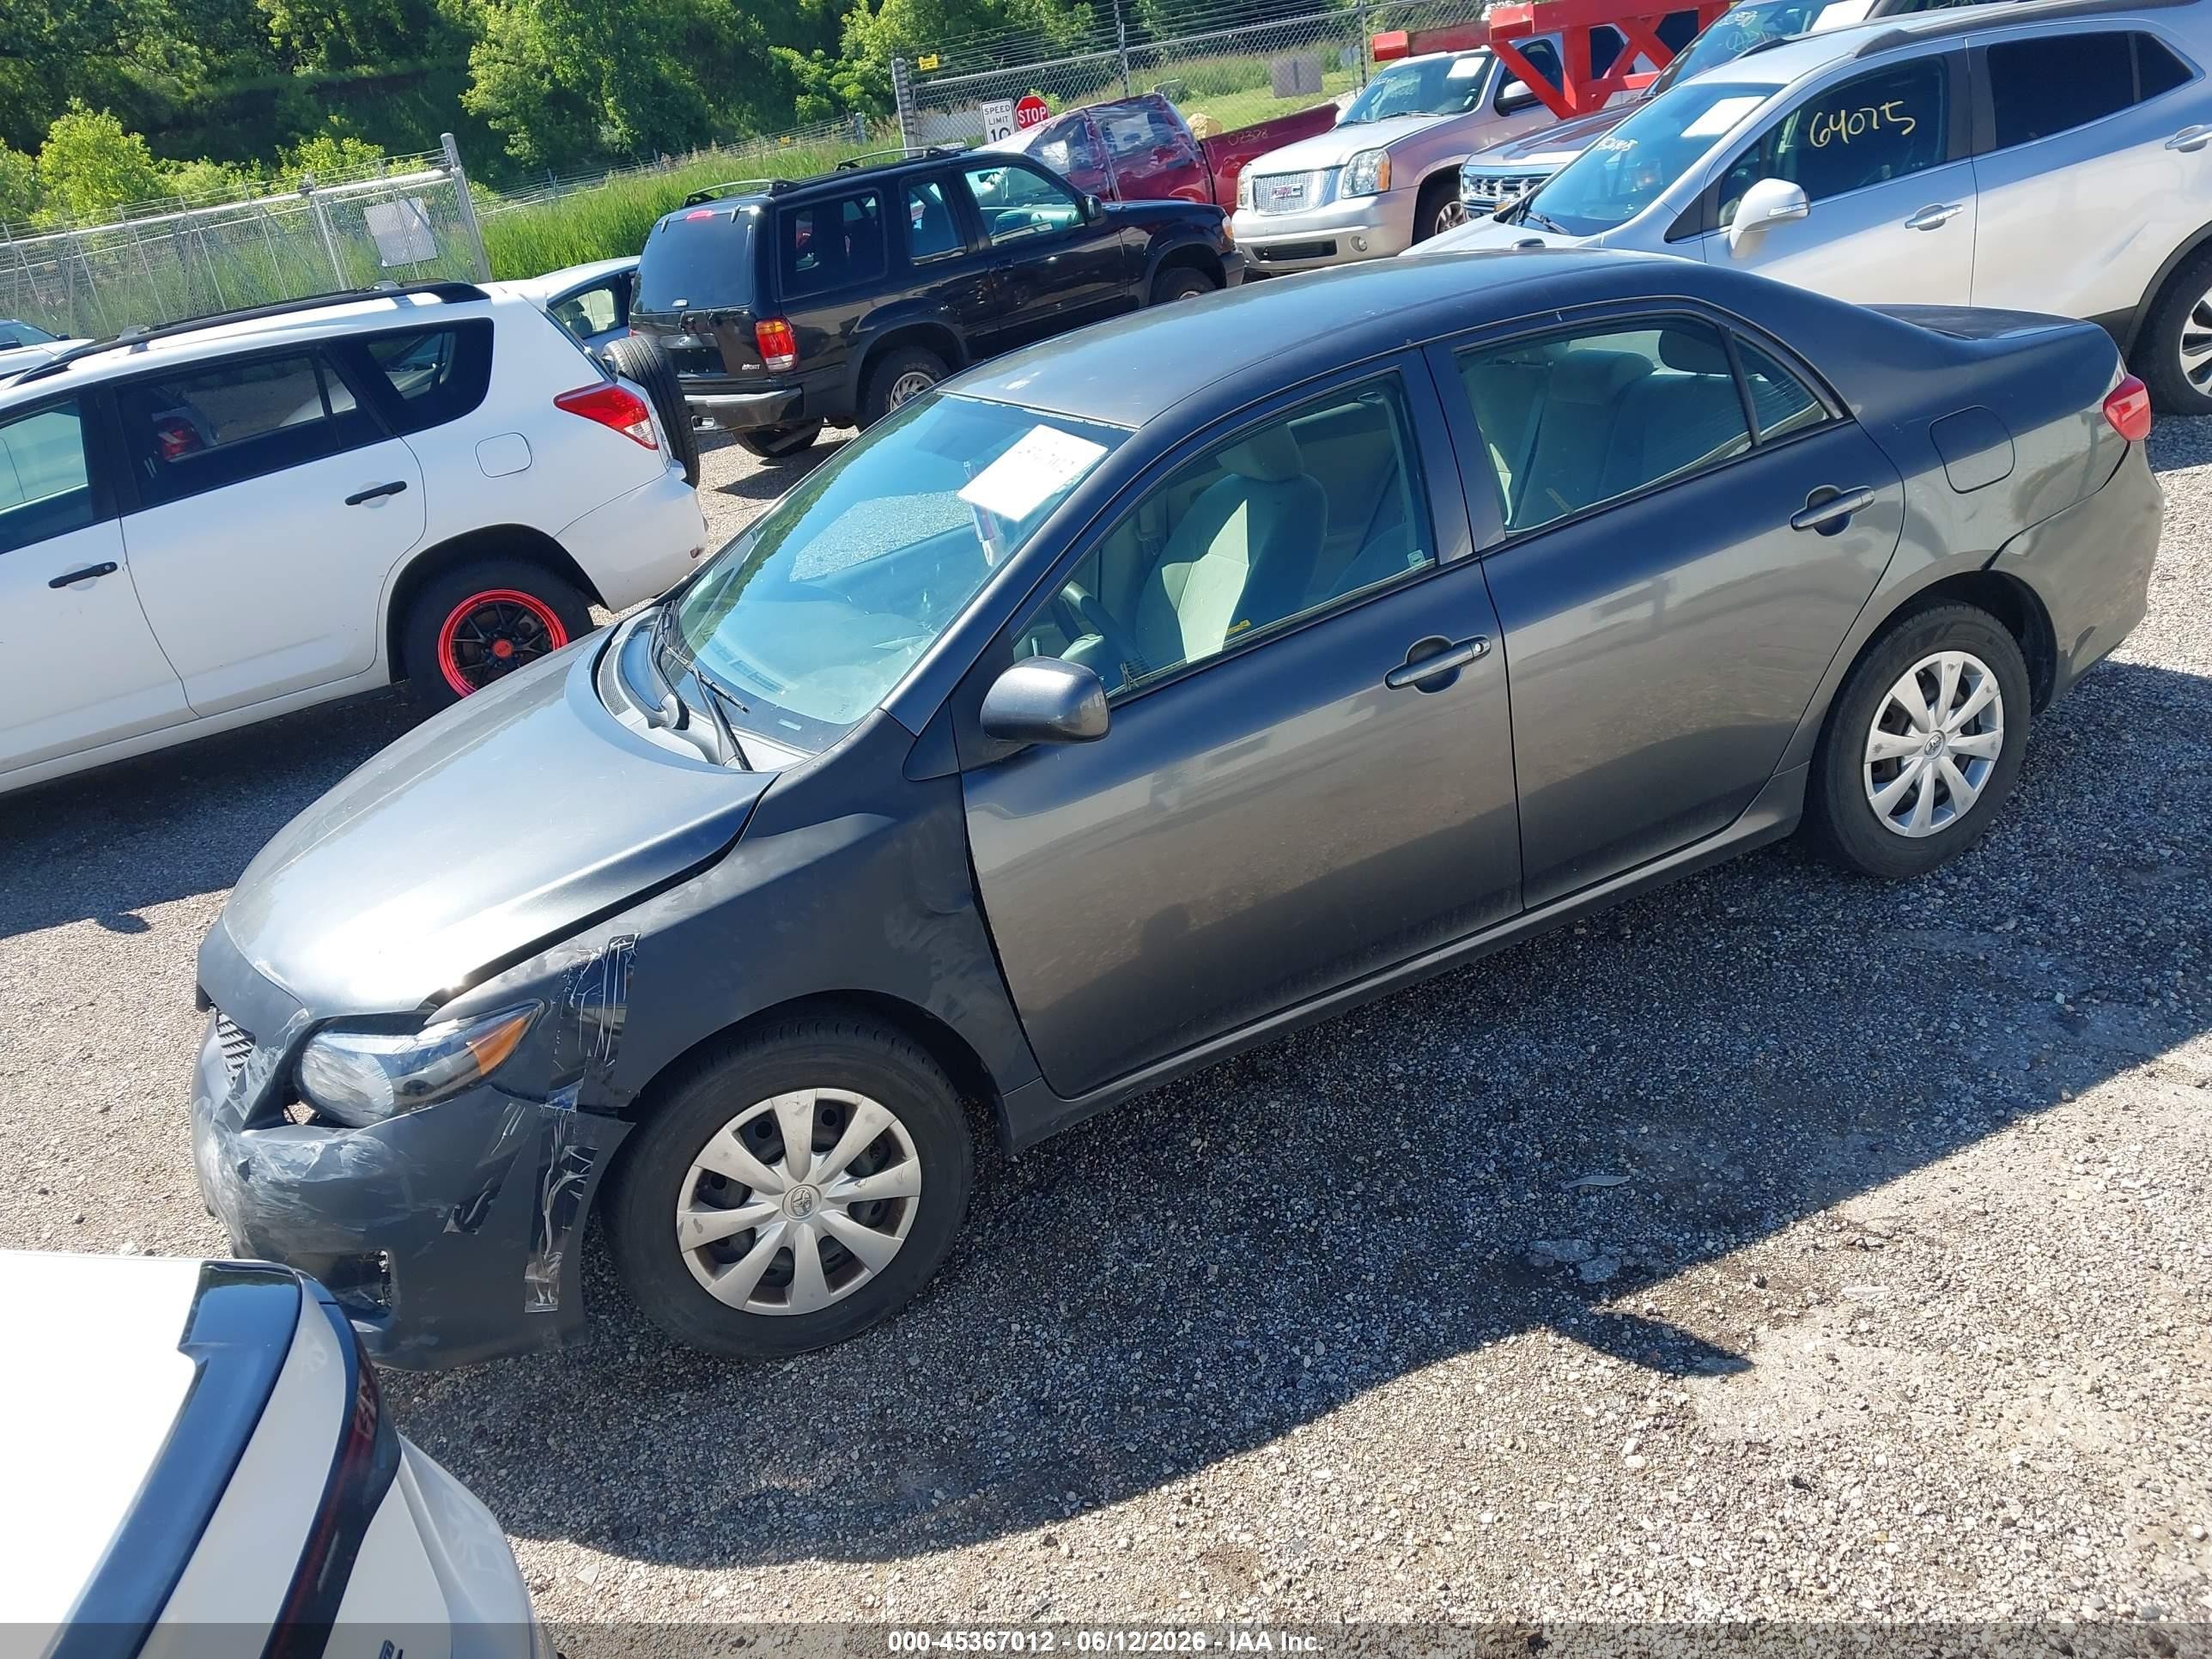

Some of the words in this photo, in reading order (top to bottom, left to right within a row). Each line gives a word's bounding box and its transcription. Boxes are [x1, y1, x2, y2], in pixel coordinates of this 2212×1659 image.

[984, 105, 1011, 115] SPEED
[1018, 106, 1047, 124] STOP
[988, 116, 1009, 125] LIMIT
[1809, 100, 1917, 148] 64075
